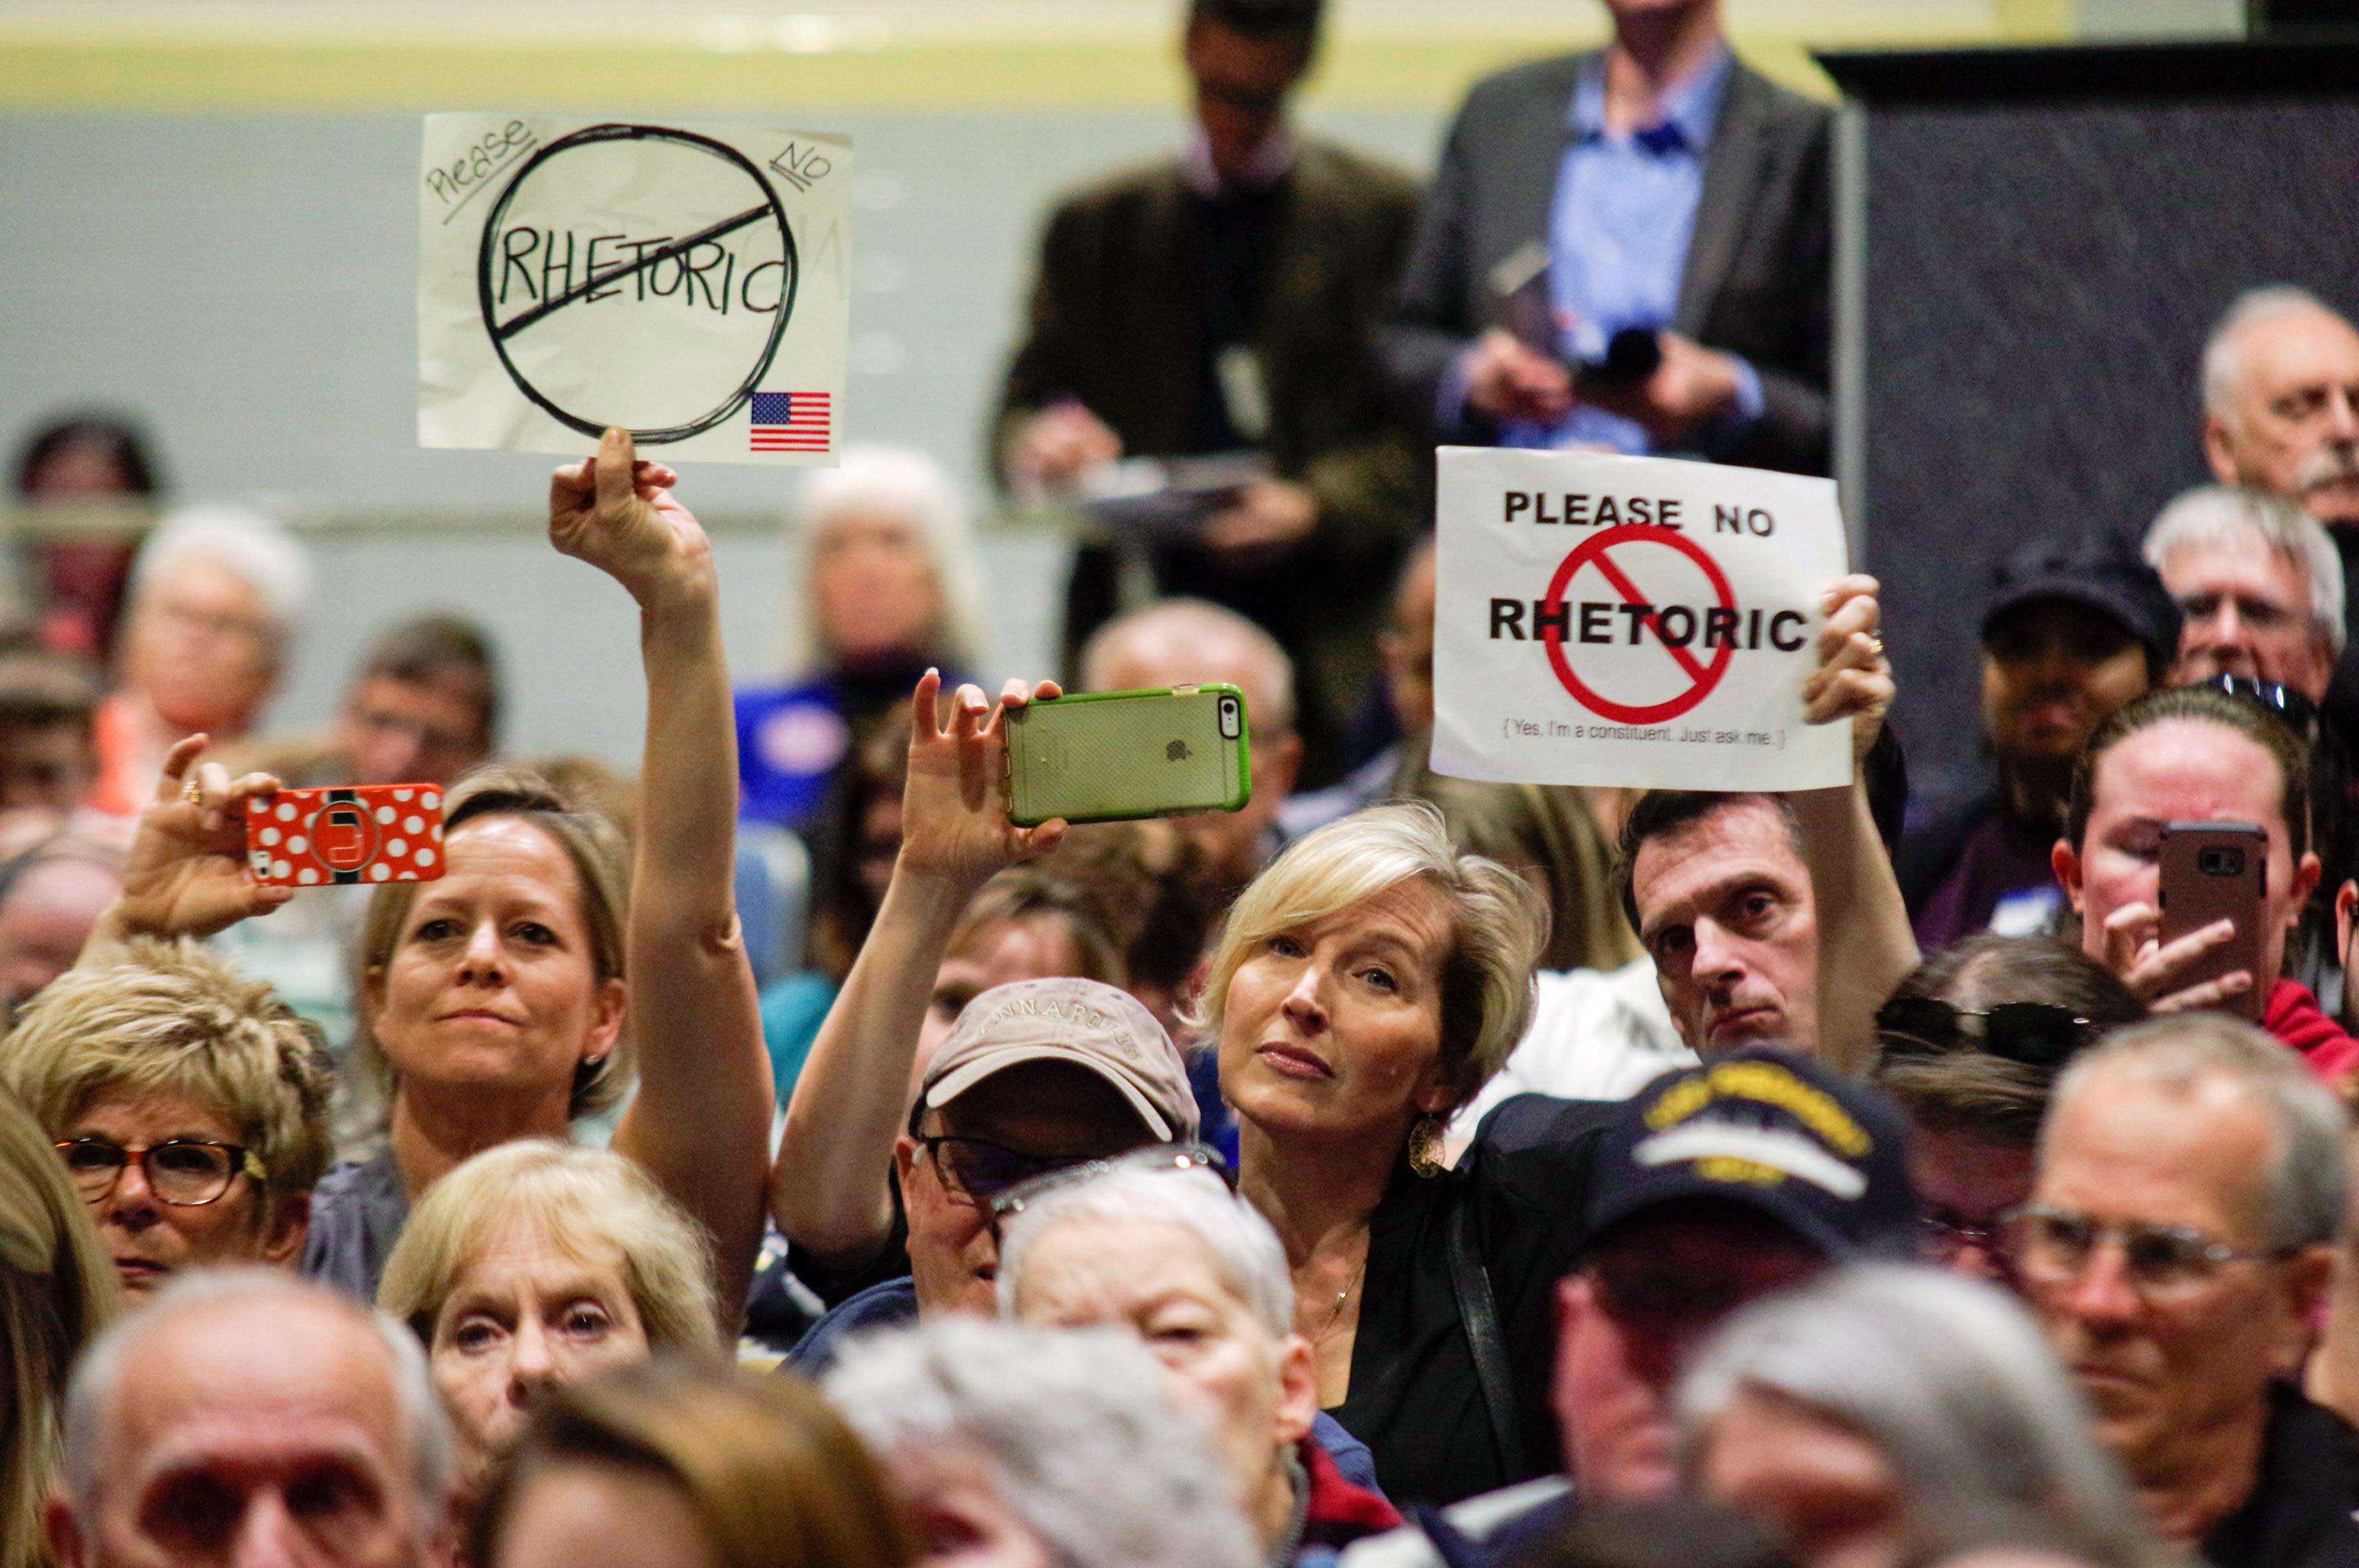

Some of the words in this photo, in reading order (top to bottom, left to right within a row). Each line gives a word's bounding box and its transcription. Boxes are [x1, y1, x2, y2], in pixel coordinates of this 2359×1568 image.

[426, 120, 532, 204] Please
[772, 140, 831, 179] NO
[499, 226, 788, 315] RHETORIC
[1504, 491, 1682, 530] PLEASE
[1714, 503, 1776, 538] NO
[1489, 598, 1810, 653] RHETORIC
[1575, 724, 1585, 739] a
[1680, 727, 1711, 743] Just
[1715, 729, 1741, 745] ask
[1747, 731, 1771, 746] me
